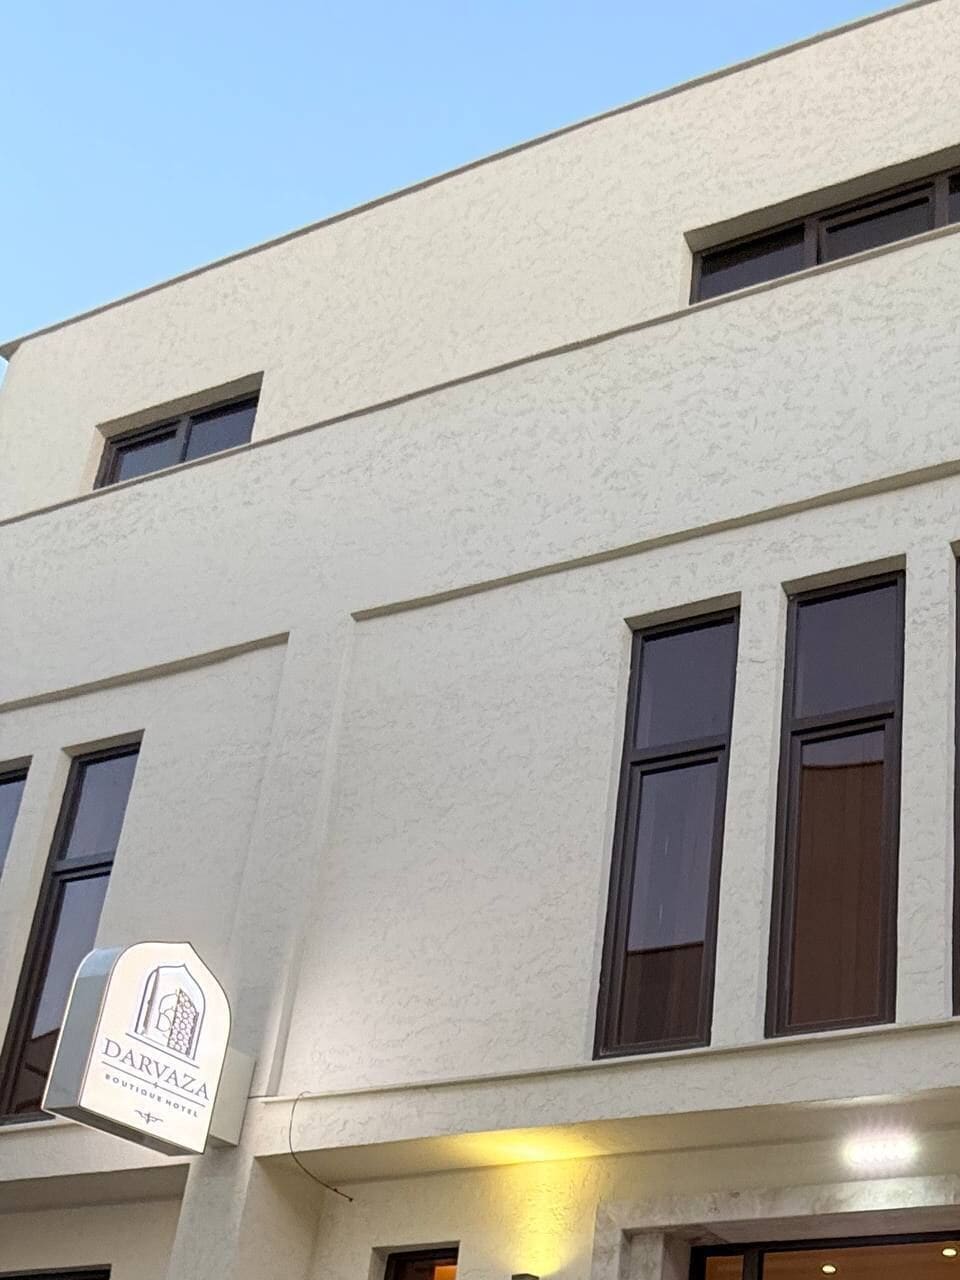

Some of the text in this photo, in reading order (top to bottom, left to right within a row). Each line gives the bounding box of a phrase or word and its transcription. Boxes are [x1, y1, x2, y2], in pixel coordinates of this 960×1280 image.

[103, 1038, 209, 1101] DARVAZA
[105, 1074, 198, 1117] BOUTIQUE HOTEL
